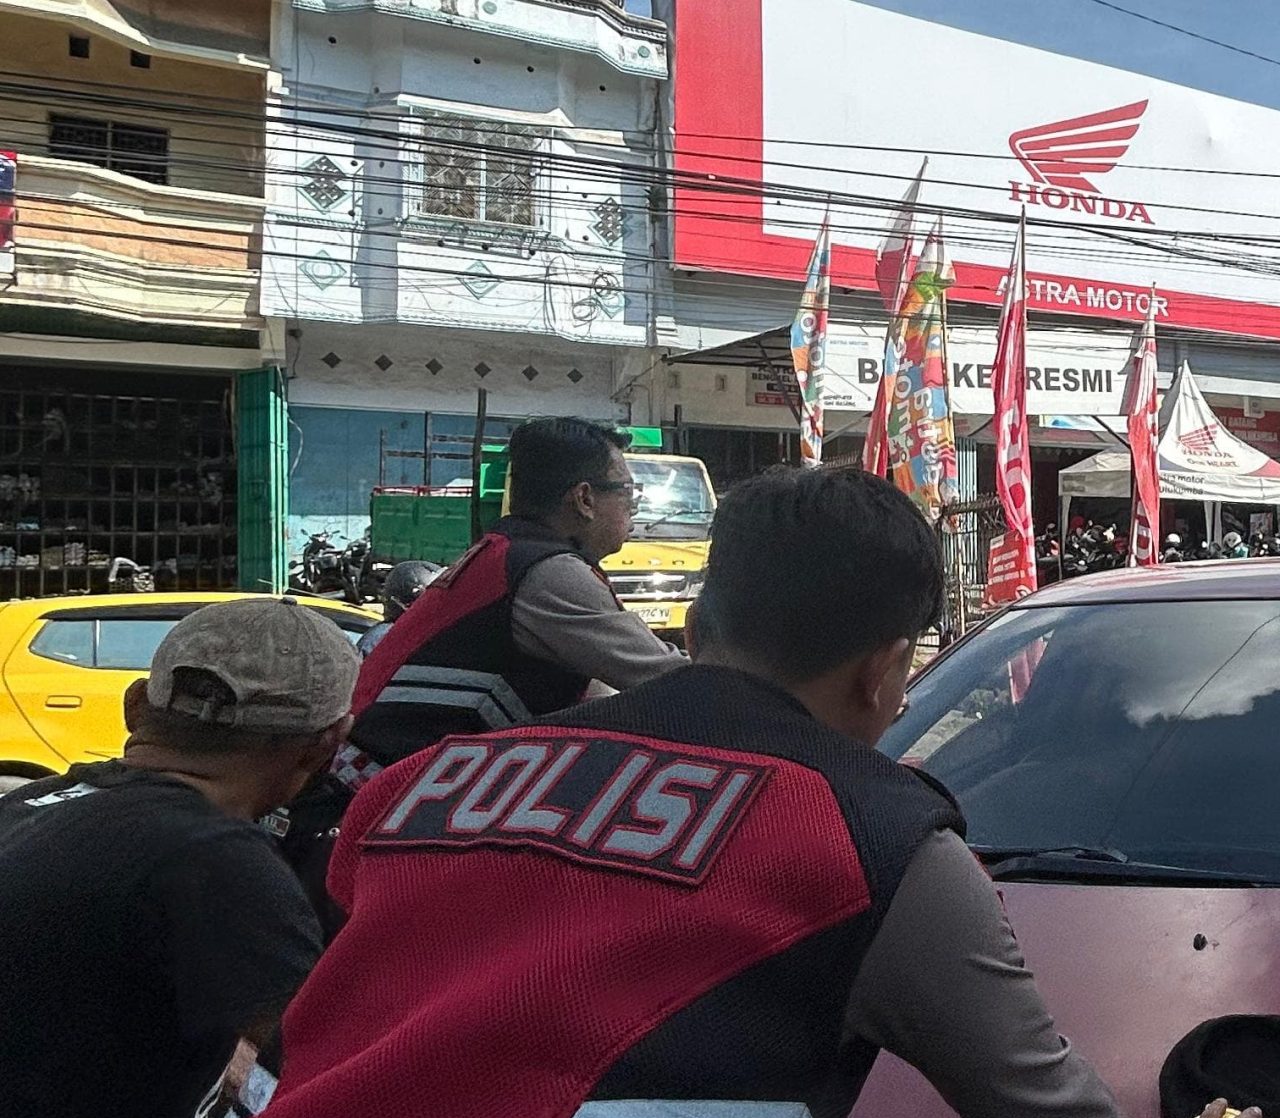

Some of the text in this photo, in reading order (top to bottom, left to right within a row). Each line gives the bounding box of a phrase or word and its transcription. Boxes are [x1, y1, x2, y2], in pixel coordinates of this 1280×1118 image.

[1008, 181, 1155, 225] HONDA
[1087, 286, 1169, 316] MOTOR
[1026, 366, 1112, 392] RESMI
[1182, 449, 1234, 458] HONDA
[380, 742, 754, 867] POLISI
